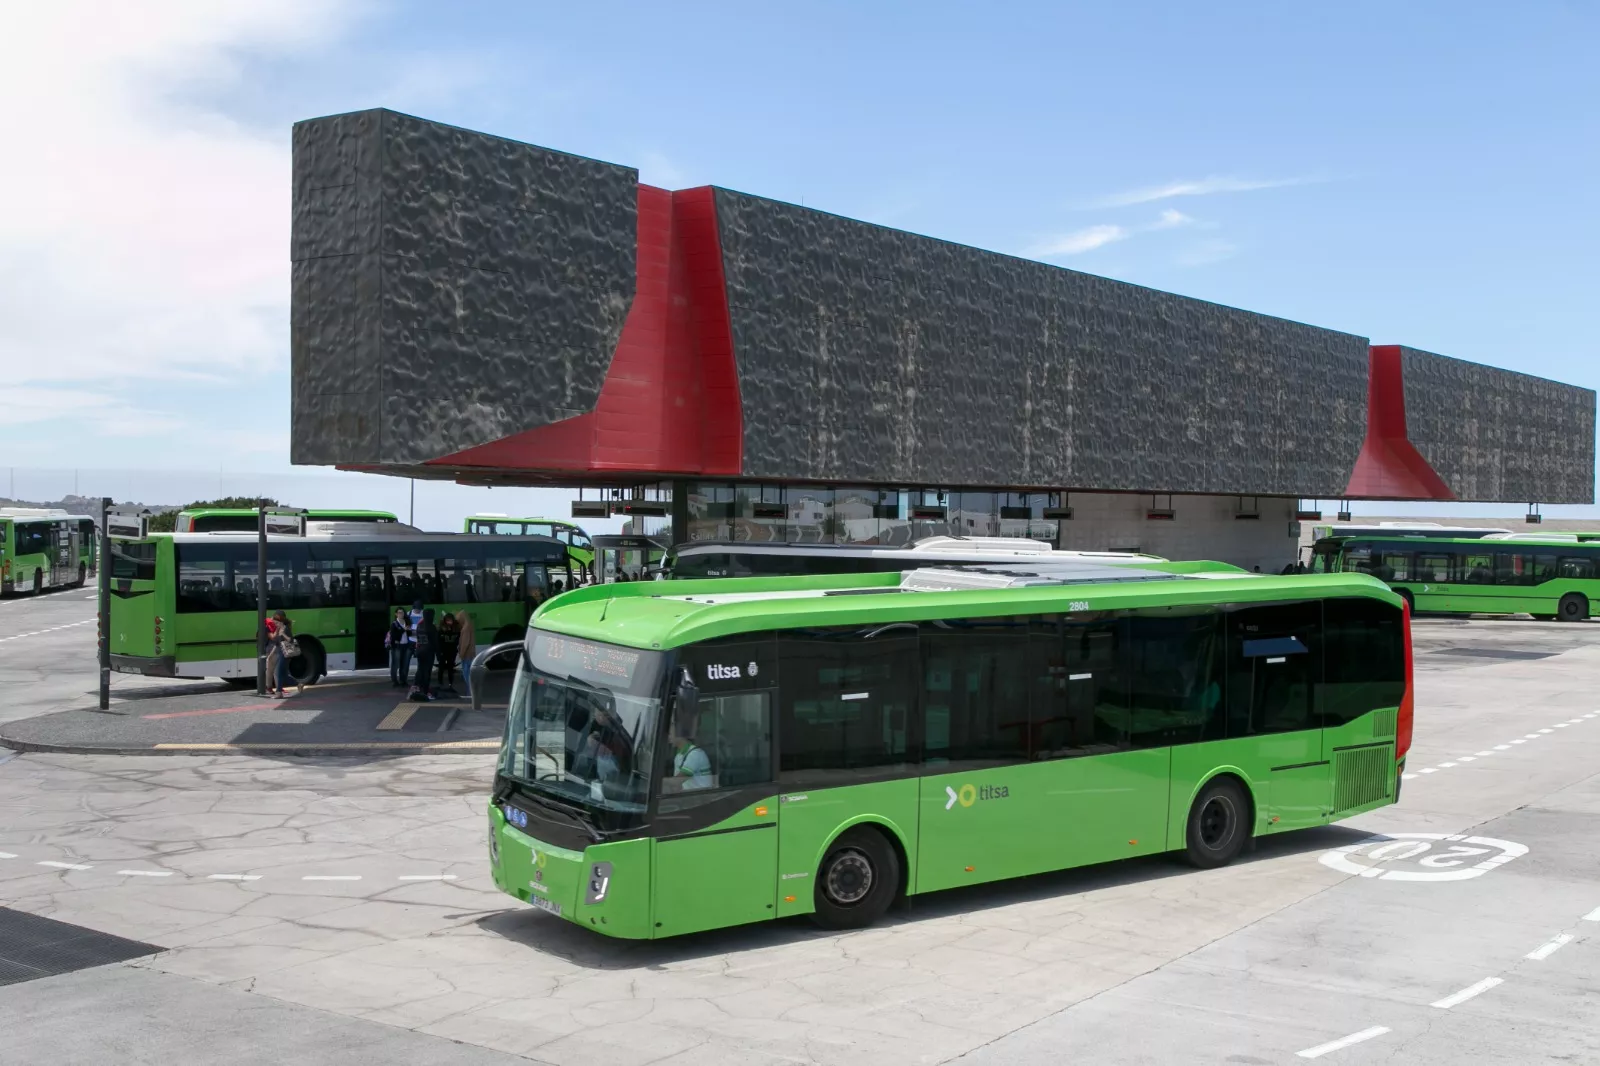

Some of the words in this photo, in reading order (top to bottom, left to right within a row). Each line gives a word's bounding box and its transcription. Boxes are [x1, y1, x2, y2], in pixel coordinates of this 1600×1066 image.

[1069, 601, 1089, 611] 2804
[707, 664, 741, 680] titsa
[980, 785, 1010, 801] titsa
[1368, 841, 1492, 867] 20
